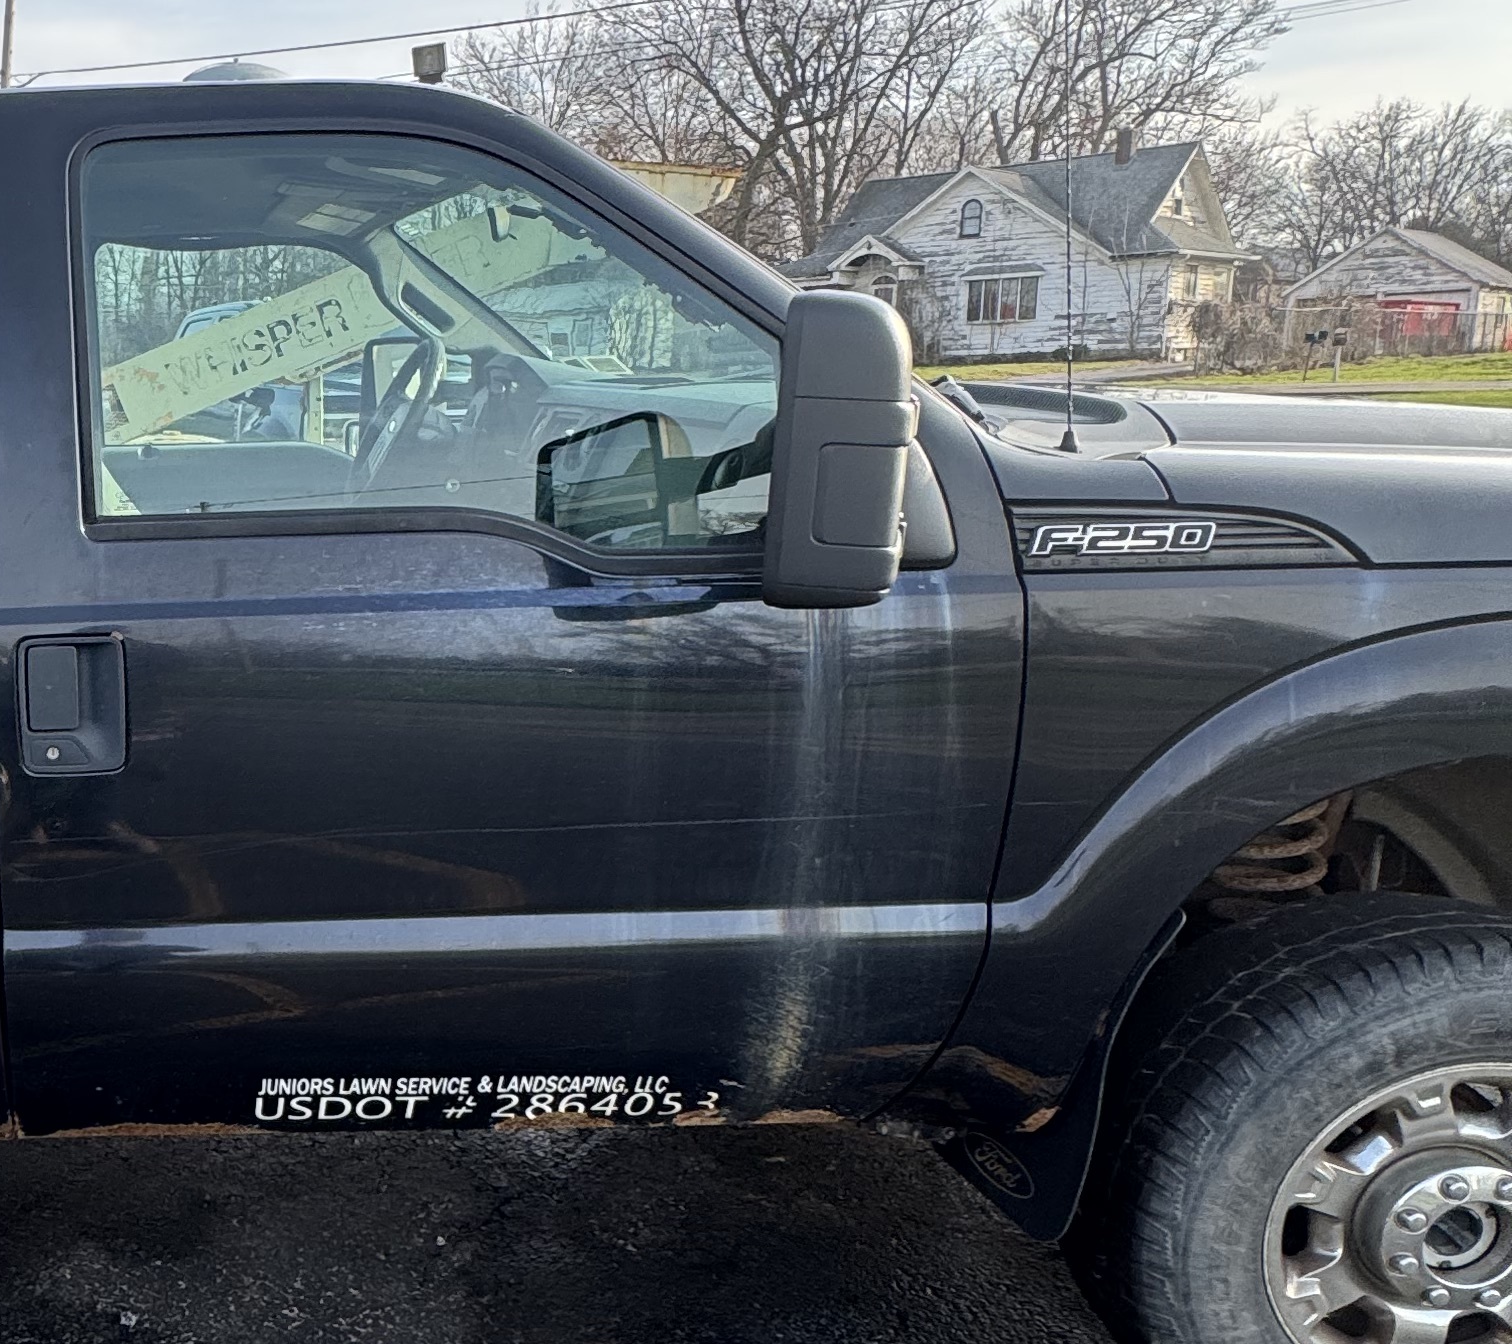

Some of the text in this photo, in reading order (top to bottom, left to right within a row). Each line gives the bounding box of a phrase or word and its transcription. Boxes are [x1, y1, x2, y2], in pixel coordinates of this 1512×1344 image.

[1029, 522, 1216, 556] F-250
[258, 1075, 669, 1096] JUNIORS LAWN SERVICE & LANDSCAPING, LLC
[254, 1096, 429, 1121] USDOT
[974, 1141, 1022, 1188] Ford
